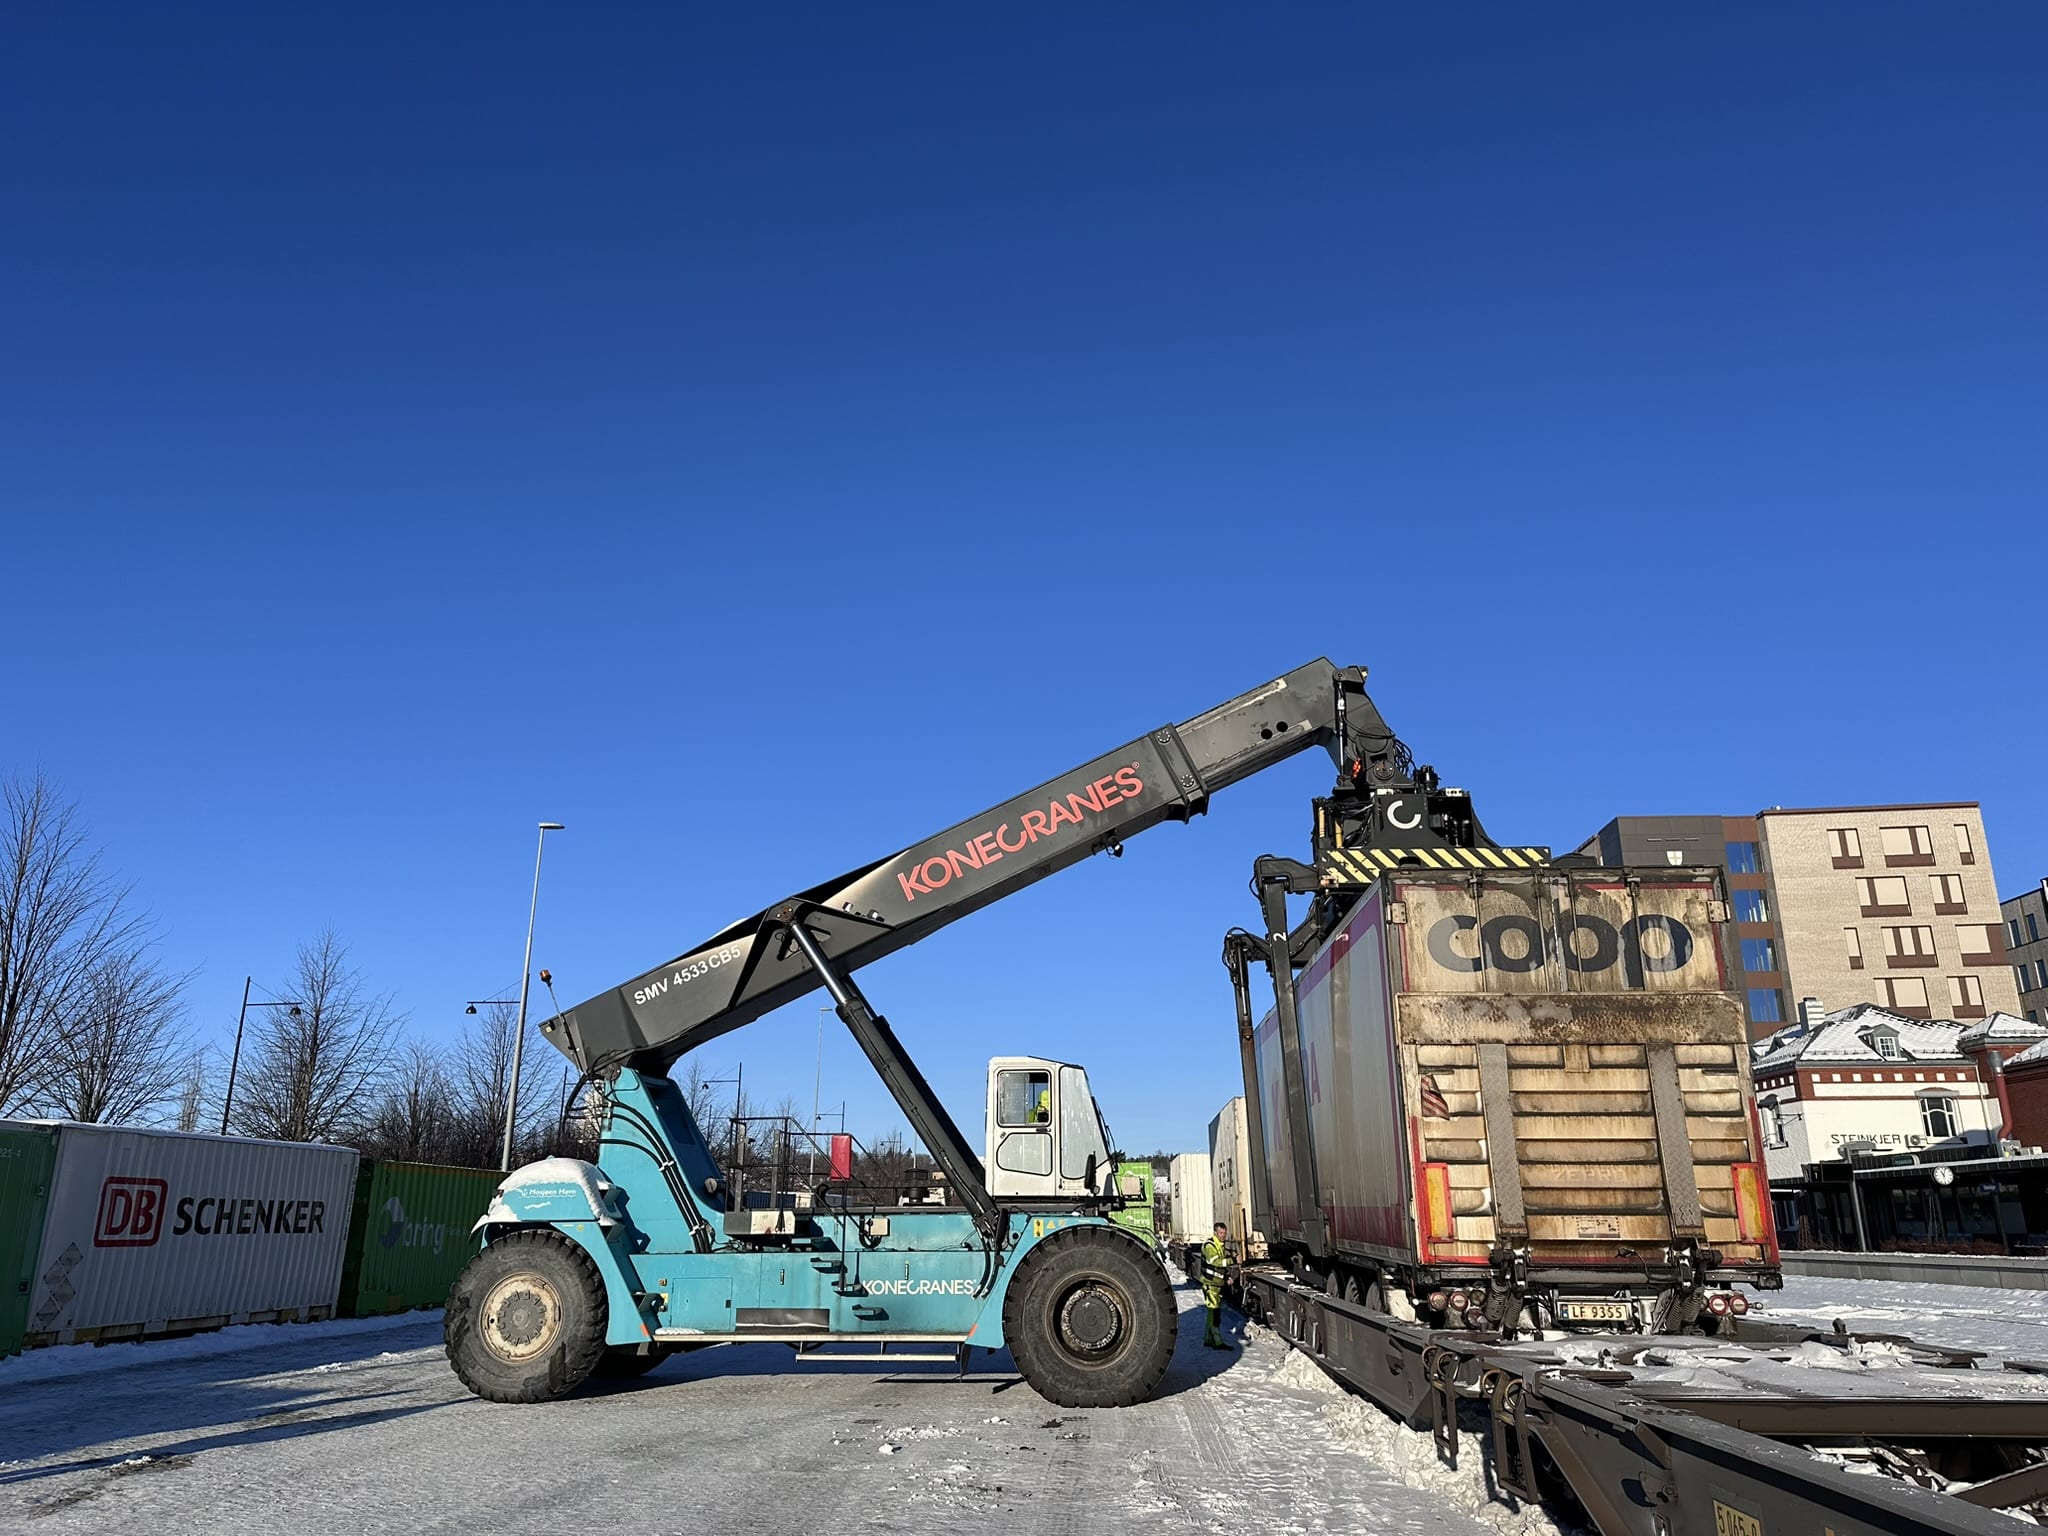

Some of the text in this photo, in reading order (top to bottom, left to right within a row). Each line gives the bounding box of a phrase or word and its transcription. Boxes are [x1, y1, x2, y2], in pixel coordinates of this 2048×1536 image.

[897, 766, 1144, 903] KONECRANES
[1273, 932, 1287, 942] 2
[1427, 914, 1693, 988] coop
[634, 945, 741, 1005] SMV 4533 CB5
[1831, 1134, 1901, 1144] STEINKJER
[103, 1187, 159, 1237] DB
[173, 1197, 325, 1236] SCHENKER
[402, 1217, 445, 1254] bring
[863, 1279, 975, 1295] KONECRANES
[1591, 1306, 1622, 1319] 9355
